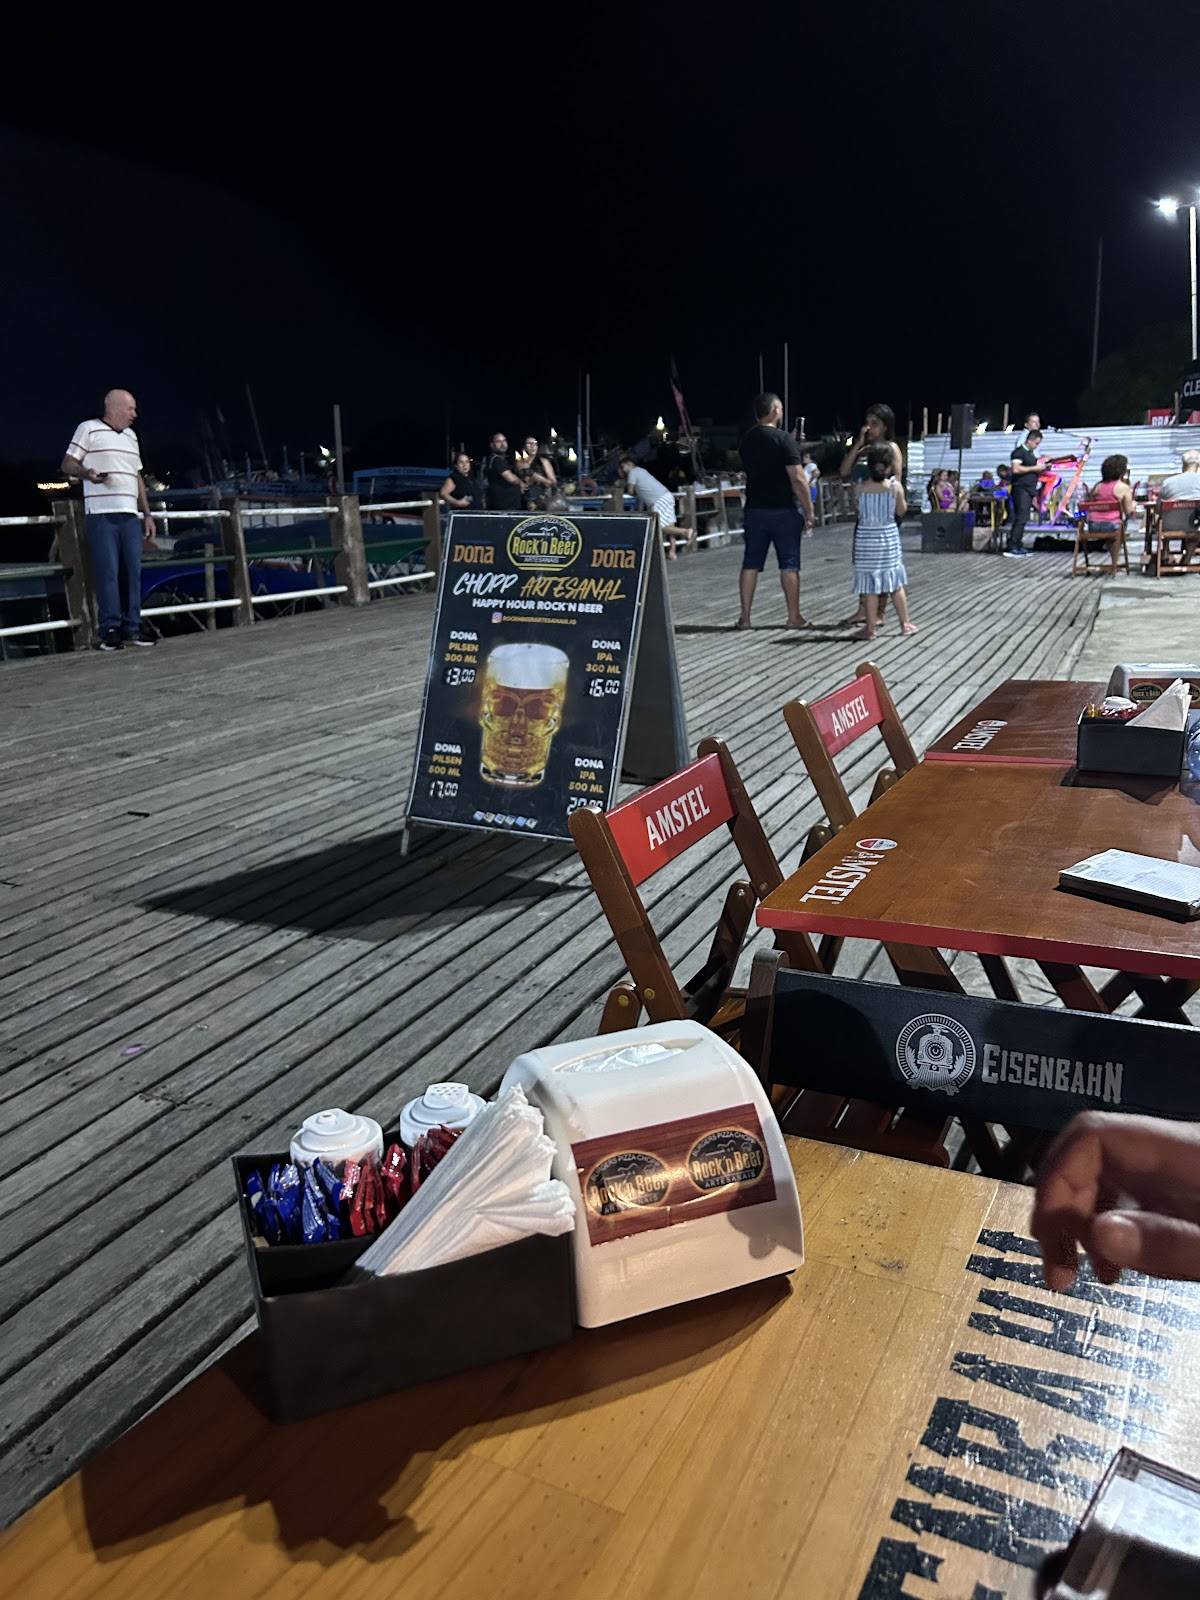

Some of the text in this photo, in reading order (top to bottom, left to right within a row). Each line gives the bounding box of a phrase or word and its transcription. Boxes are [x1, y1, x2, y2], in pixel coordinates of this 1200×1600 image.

[453, 573, 626, 601] CHOPP ARTESANAL
[472, 598, 505, 609] HAPPY
[506, 600, 535, 610] HOUR
[578, 603, 604, 614] BEER
[450, 630, 478, 641] DONA
[448, 642, 479, 652] PILSEN
[592, 639, 621, 650] DONA
[444, 652, 478, 664] 300 ML
[596, 652, 613, 661] IPA
[584, 663, 622, 674] 300 ML
[831, 695, 869, 737] AMSTEL
[434, 742, 462, 754] DONA
[432, 754, 463, 766] PILSEN
[574, 757, 604, 769] DONA
[428, 765, 461, 777] 500 ML
[580, 770, 596, 780] IPA
[568, 781, 604, 793] 500 ML
[645, 784, 711, 851] AMSTEL
[799, 849, 886, 903] AMSTEL
[981, 1042, 1124, 1104] EISENBAHN
[705, 1171, 757, 1188] ARTESANAIS
